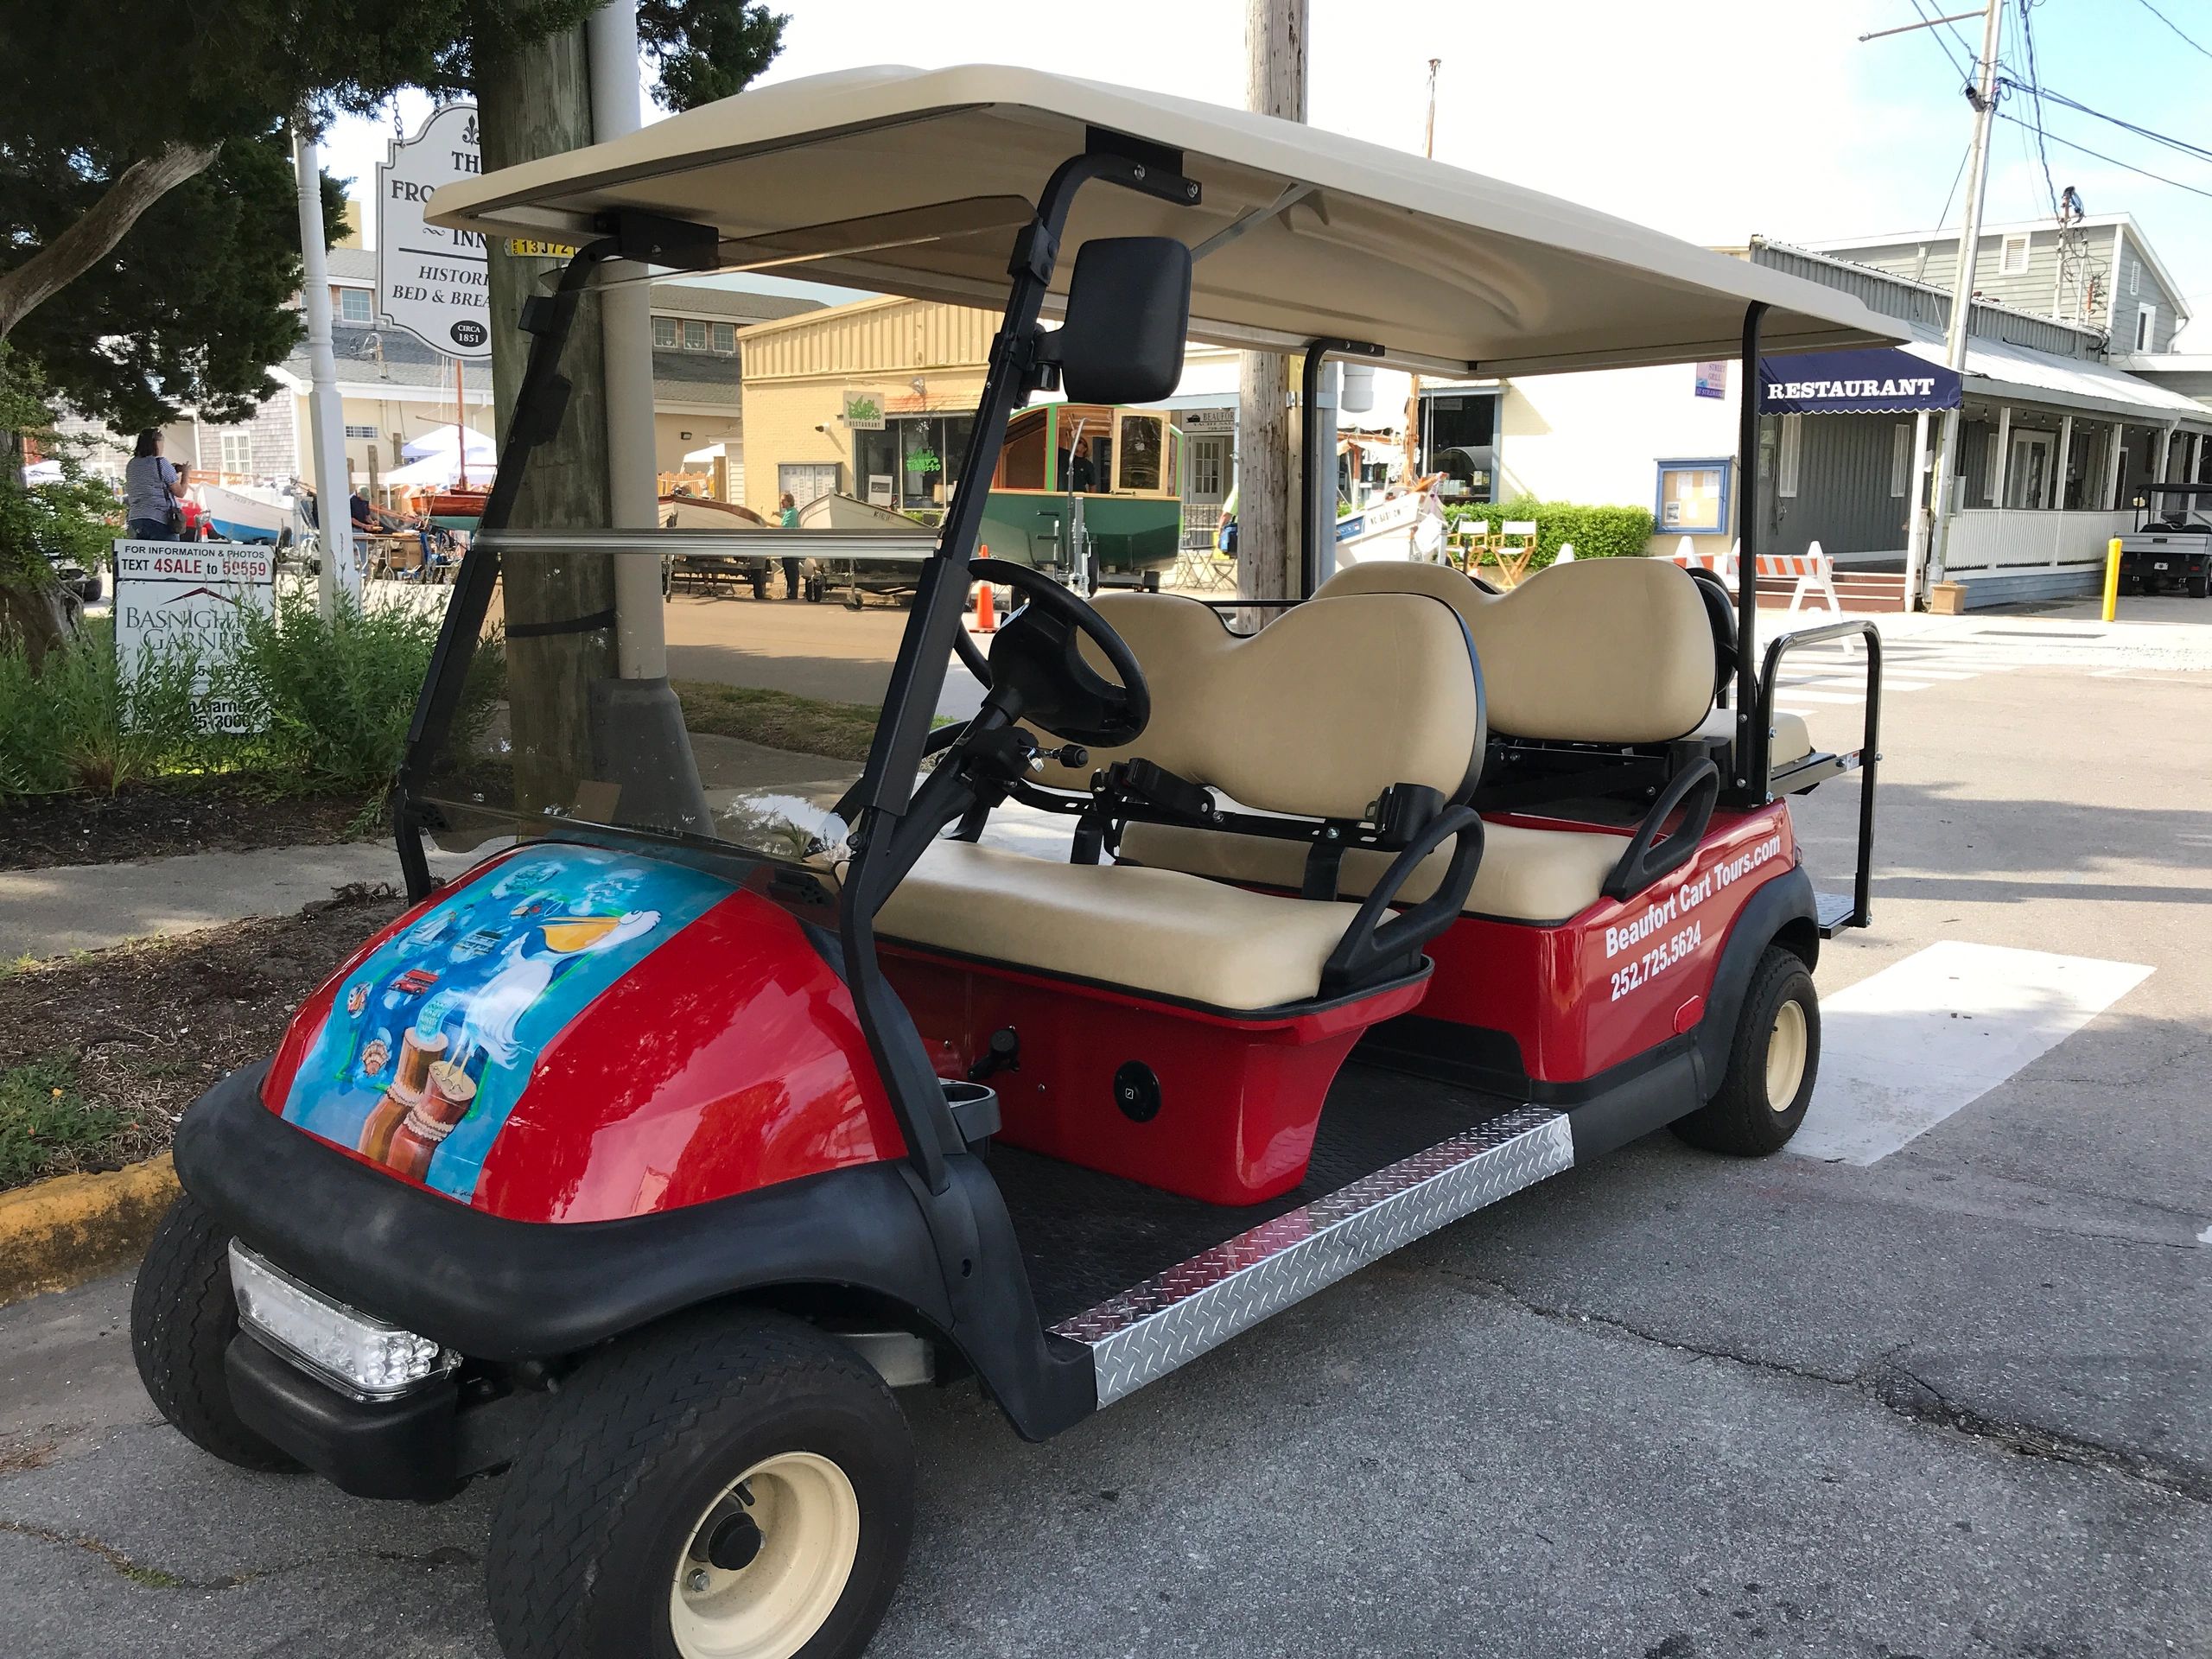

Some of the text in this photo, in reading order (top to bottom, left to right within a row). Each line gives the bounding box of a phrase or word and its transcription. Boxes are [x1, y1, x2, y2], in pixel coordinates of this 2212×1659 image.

[452, 151, 480, 174] TH
[391, 180, 435, 203] FRO
[418, 265, 489, 286] HISTORI
[392, 284, 490, 308] BED & BREA
[457, 324, 480, 333] CIRCA
[458, 333, 479, 342] 1851
[1767, 378, 1935, 399] RESTAURANT
[1204, 412, 1235, 421] BEAUFOR
[124, 545, 146, 554] FOR
[149, 546, 215, 556] INFORMATION
[227, 550, 264, 559] PHOTOS
[122, 559, 149, 570] TEXT
[154, 558, 202, 574] 4SALE
[207, 563, 218, 575] to
[1605, 835, 1781, 959] Beaufort Cart Tours.com
[1611, 920, 1701, 1001] 252.725.5624
